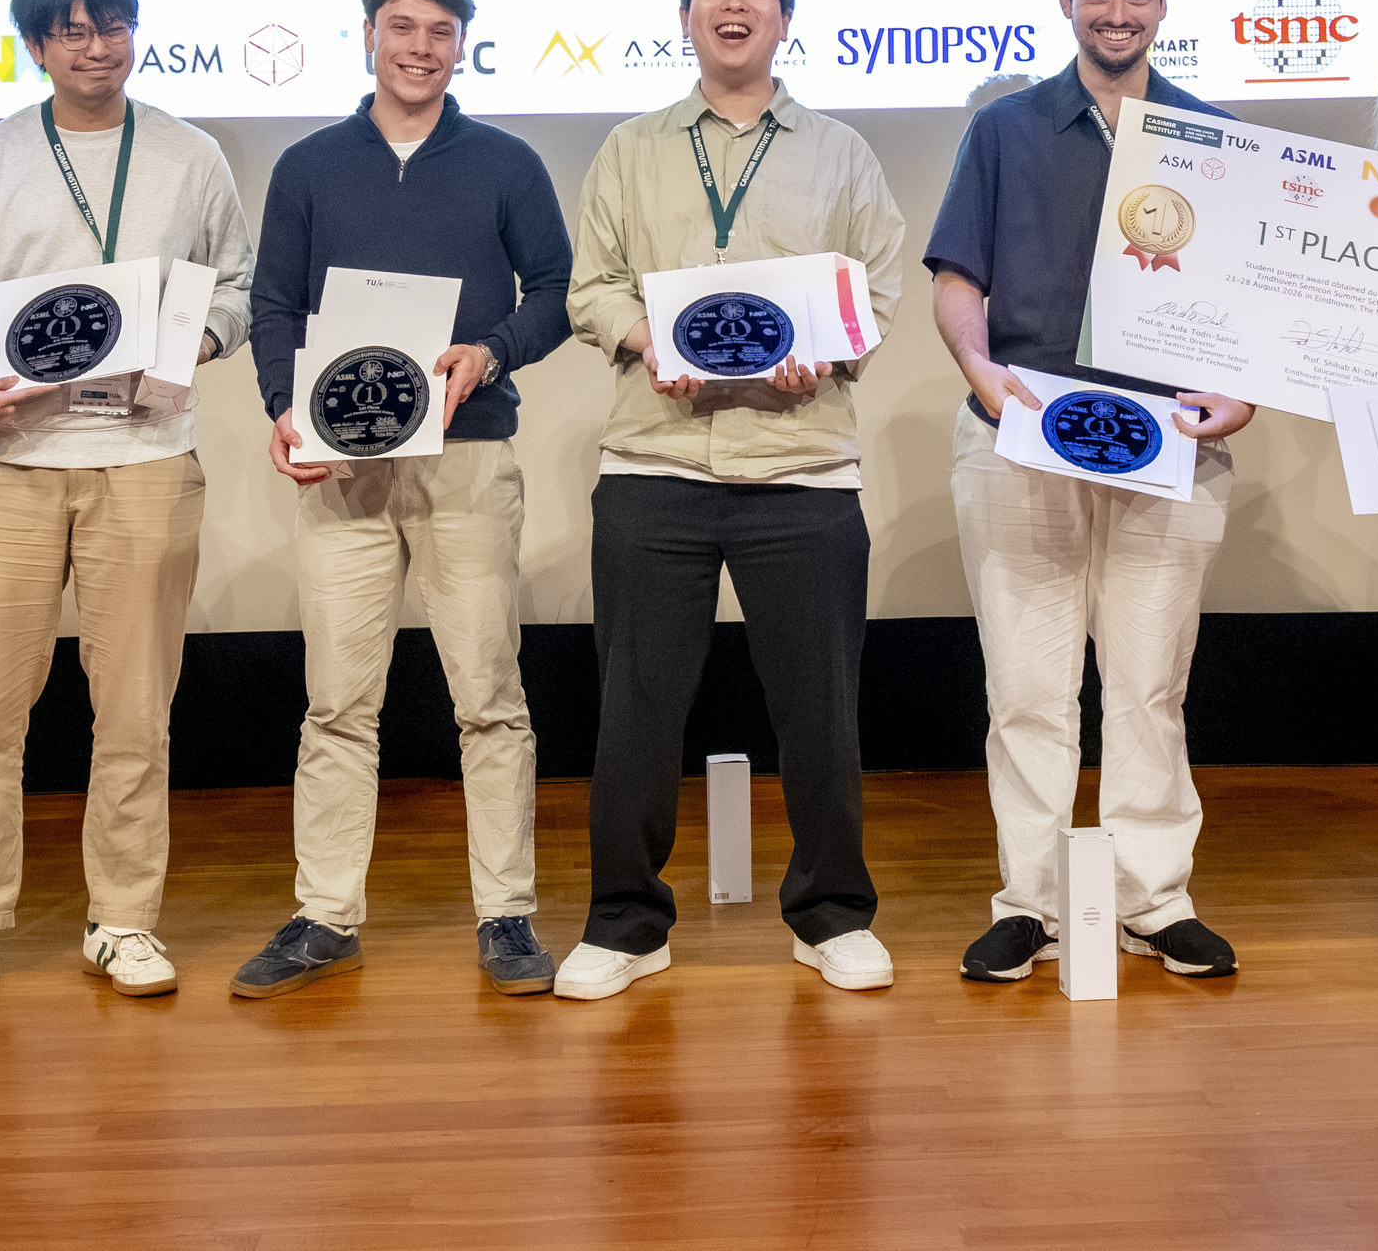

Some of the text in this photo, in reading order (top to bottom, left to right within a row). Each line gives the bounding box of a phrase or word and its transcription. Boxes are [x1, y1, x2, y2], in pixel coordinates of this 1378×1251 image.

[1231, 12, 1360, 45] tsmc
[139, 44, 223, 74] ASM
[1147, 56, 1199, 67] TONICS
[1090, 105, 1107, 130] CASIMIR
[1146, 117, 1177, 129] CASIMIR
[1145, 125, 1181, 136] INSTITUTE
[1226, 135, 1260, 152] TU/e
[739, 119, 778, 187] CASIMIR INSTITUTE TU
[1281, 147, 1336, 170] ASML
[1159, 154, 1193, 171] ASM
[53, 143, 70, 172] CASIMIR
[65, 171, 86, 205] INSTITUTE
[703, 171, 713, 187] TU/e
[1281, 179, 1324, 197] tsmc
[1244, 261, 1275, 274] Student
[1277, 266, 1304, 280] project
[1306, 274, 1330, 286] award
[1332, 279, 1366, 294] obtained
[1225, 274, 1251, 286] 23-28
[1253, 281, 1281, 294] August
[1283, 287, 1303, 298] 2026
[1314, 294, 1357, 312] Eindhoven,
[1359, 305, 1374, 315] The
[1257, 273, 1298, 288] Eindhoven
[1299, 282, 1332, 295] Semicon
[1334, 290, 1366, 303] Summer
[1157, 330, 1216, 348] Scientific Director
[1169, 323, 1188, 334] Aida
[1191, 328, 1239, 345] Todri-Sanial
[1122, 330, 1249, 364] Eindhoven Semicon Summer School
[1125, 340, 1160, 353] Eindhoven
[1162, 348, 1194, 361] University
[1205, 358, 1243, 373] Technology
[1303, 354, 1321, 365] Prof.
[1324, 359, 1350, 371] Shihab
[1284, 368, 1321, 381] Eindhoven
[1313, 366, 1351, 380] Educational
[1286, 376, 1320, 389] Eindhoven
[365, 386, 374, 403] 1
